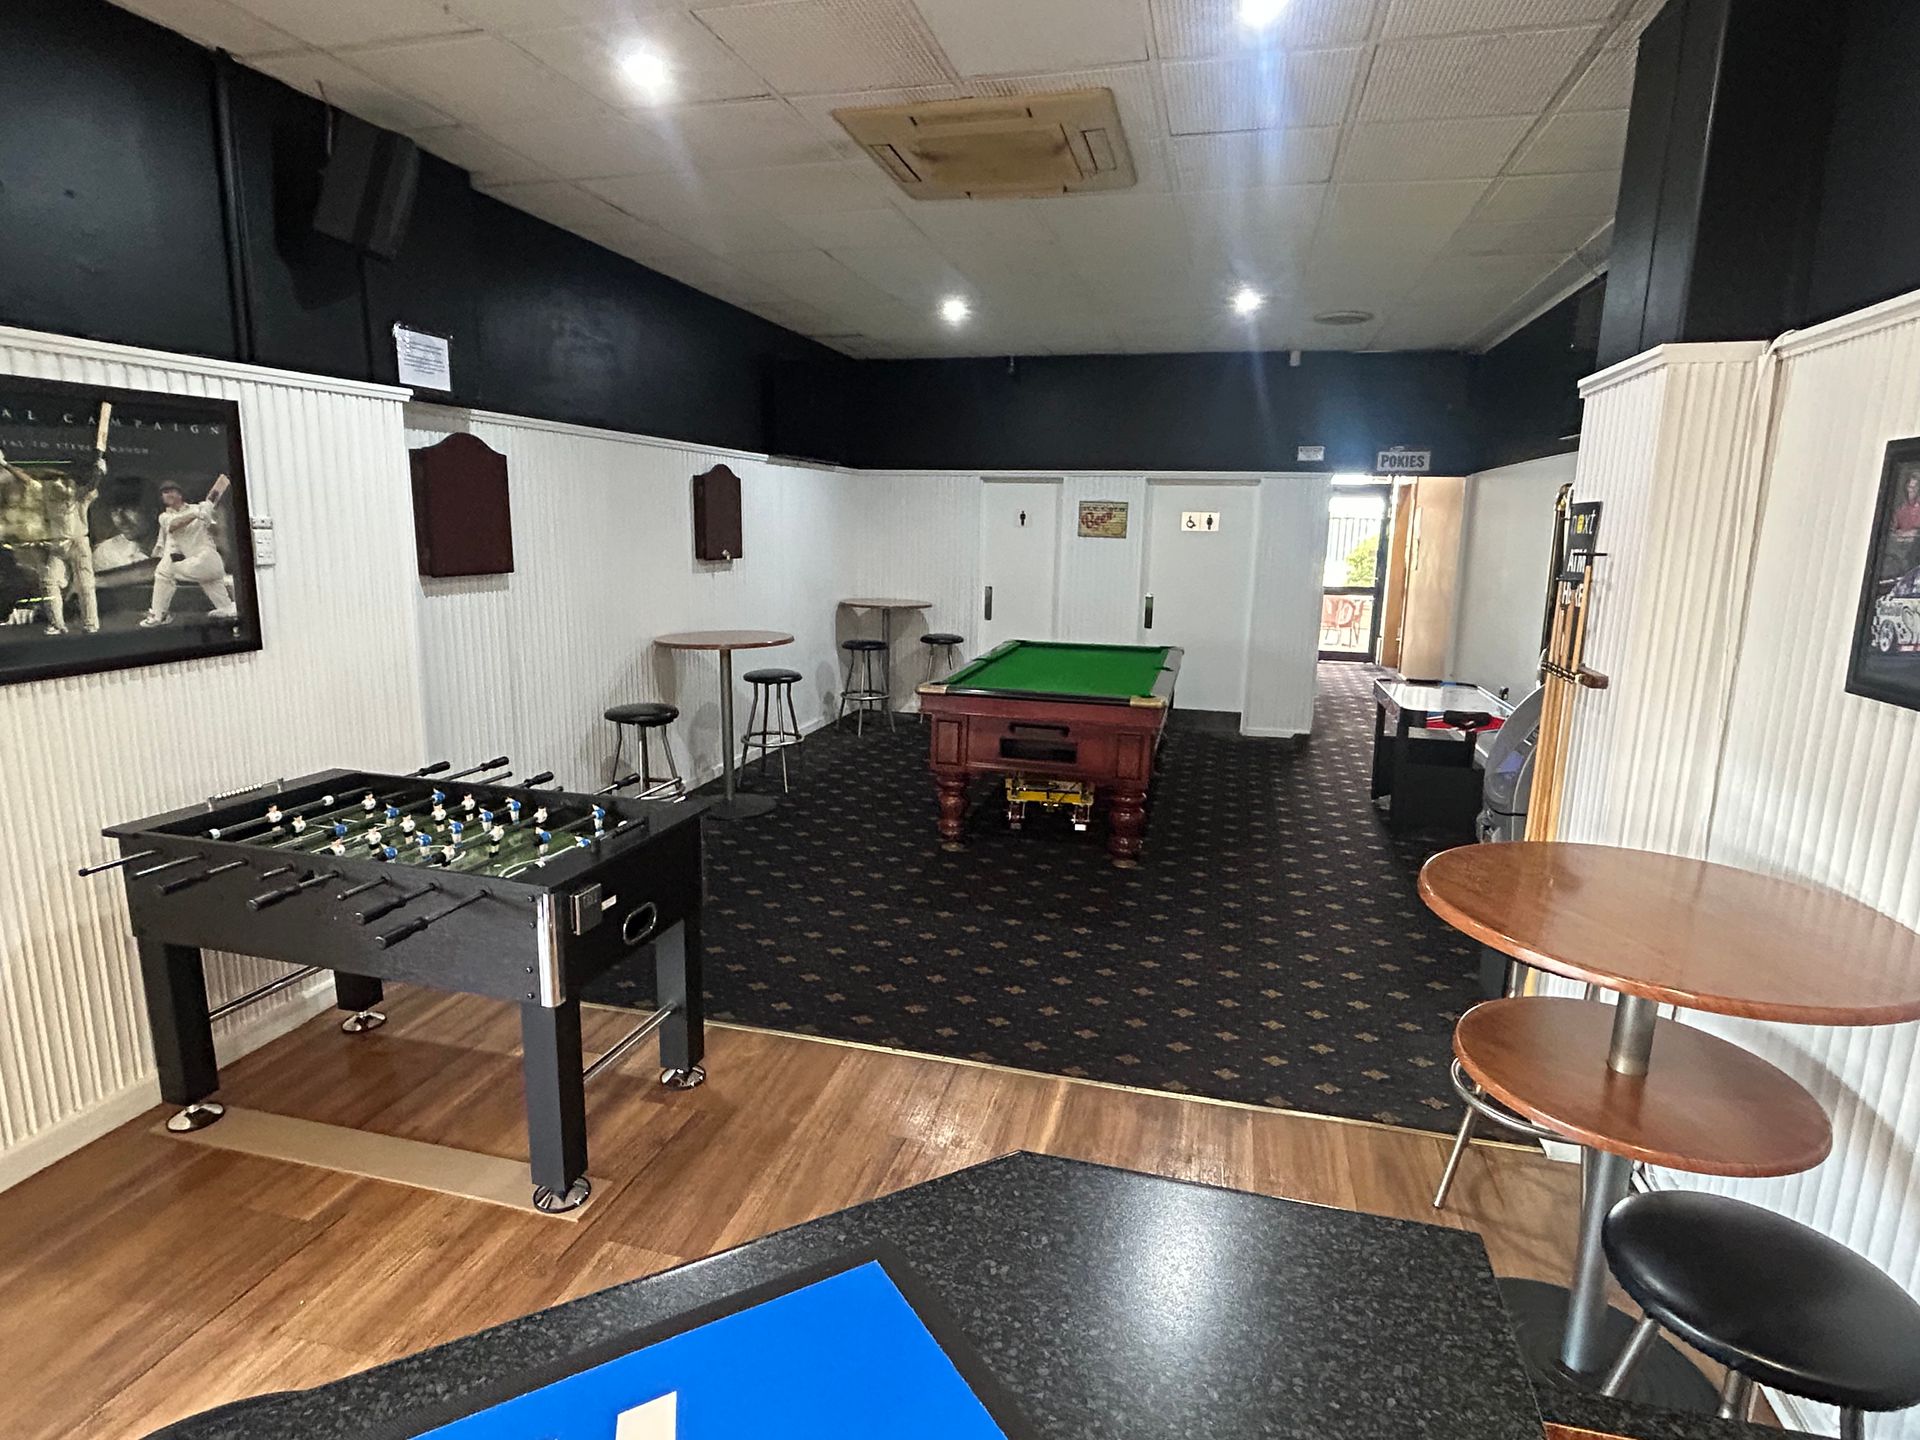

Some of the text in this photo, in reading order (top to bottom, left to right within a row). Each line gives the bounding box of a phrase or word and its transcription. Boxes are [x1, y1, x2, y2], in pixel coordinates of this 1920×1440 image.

[63, 412, 220, 435] CAMPAIGN
[1381, 454, 1425, 468] POKIES
[1567, 549, 1587, 573] ATM
